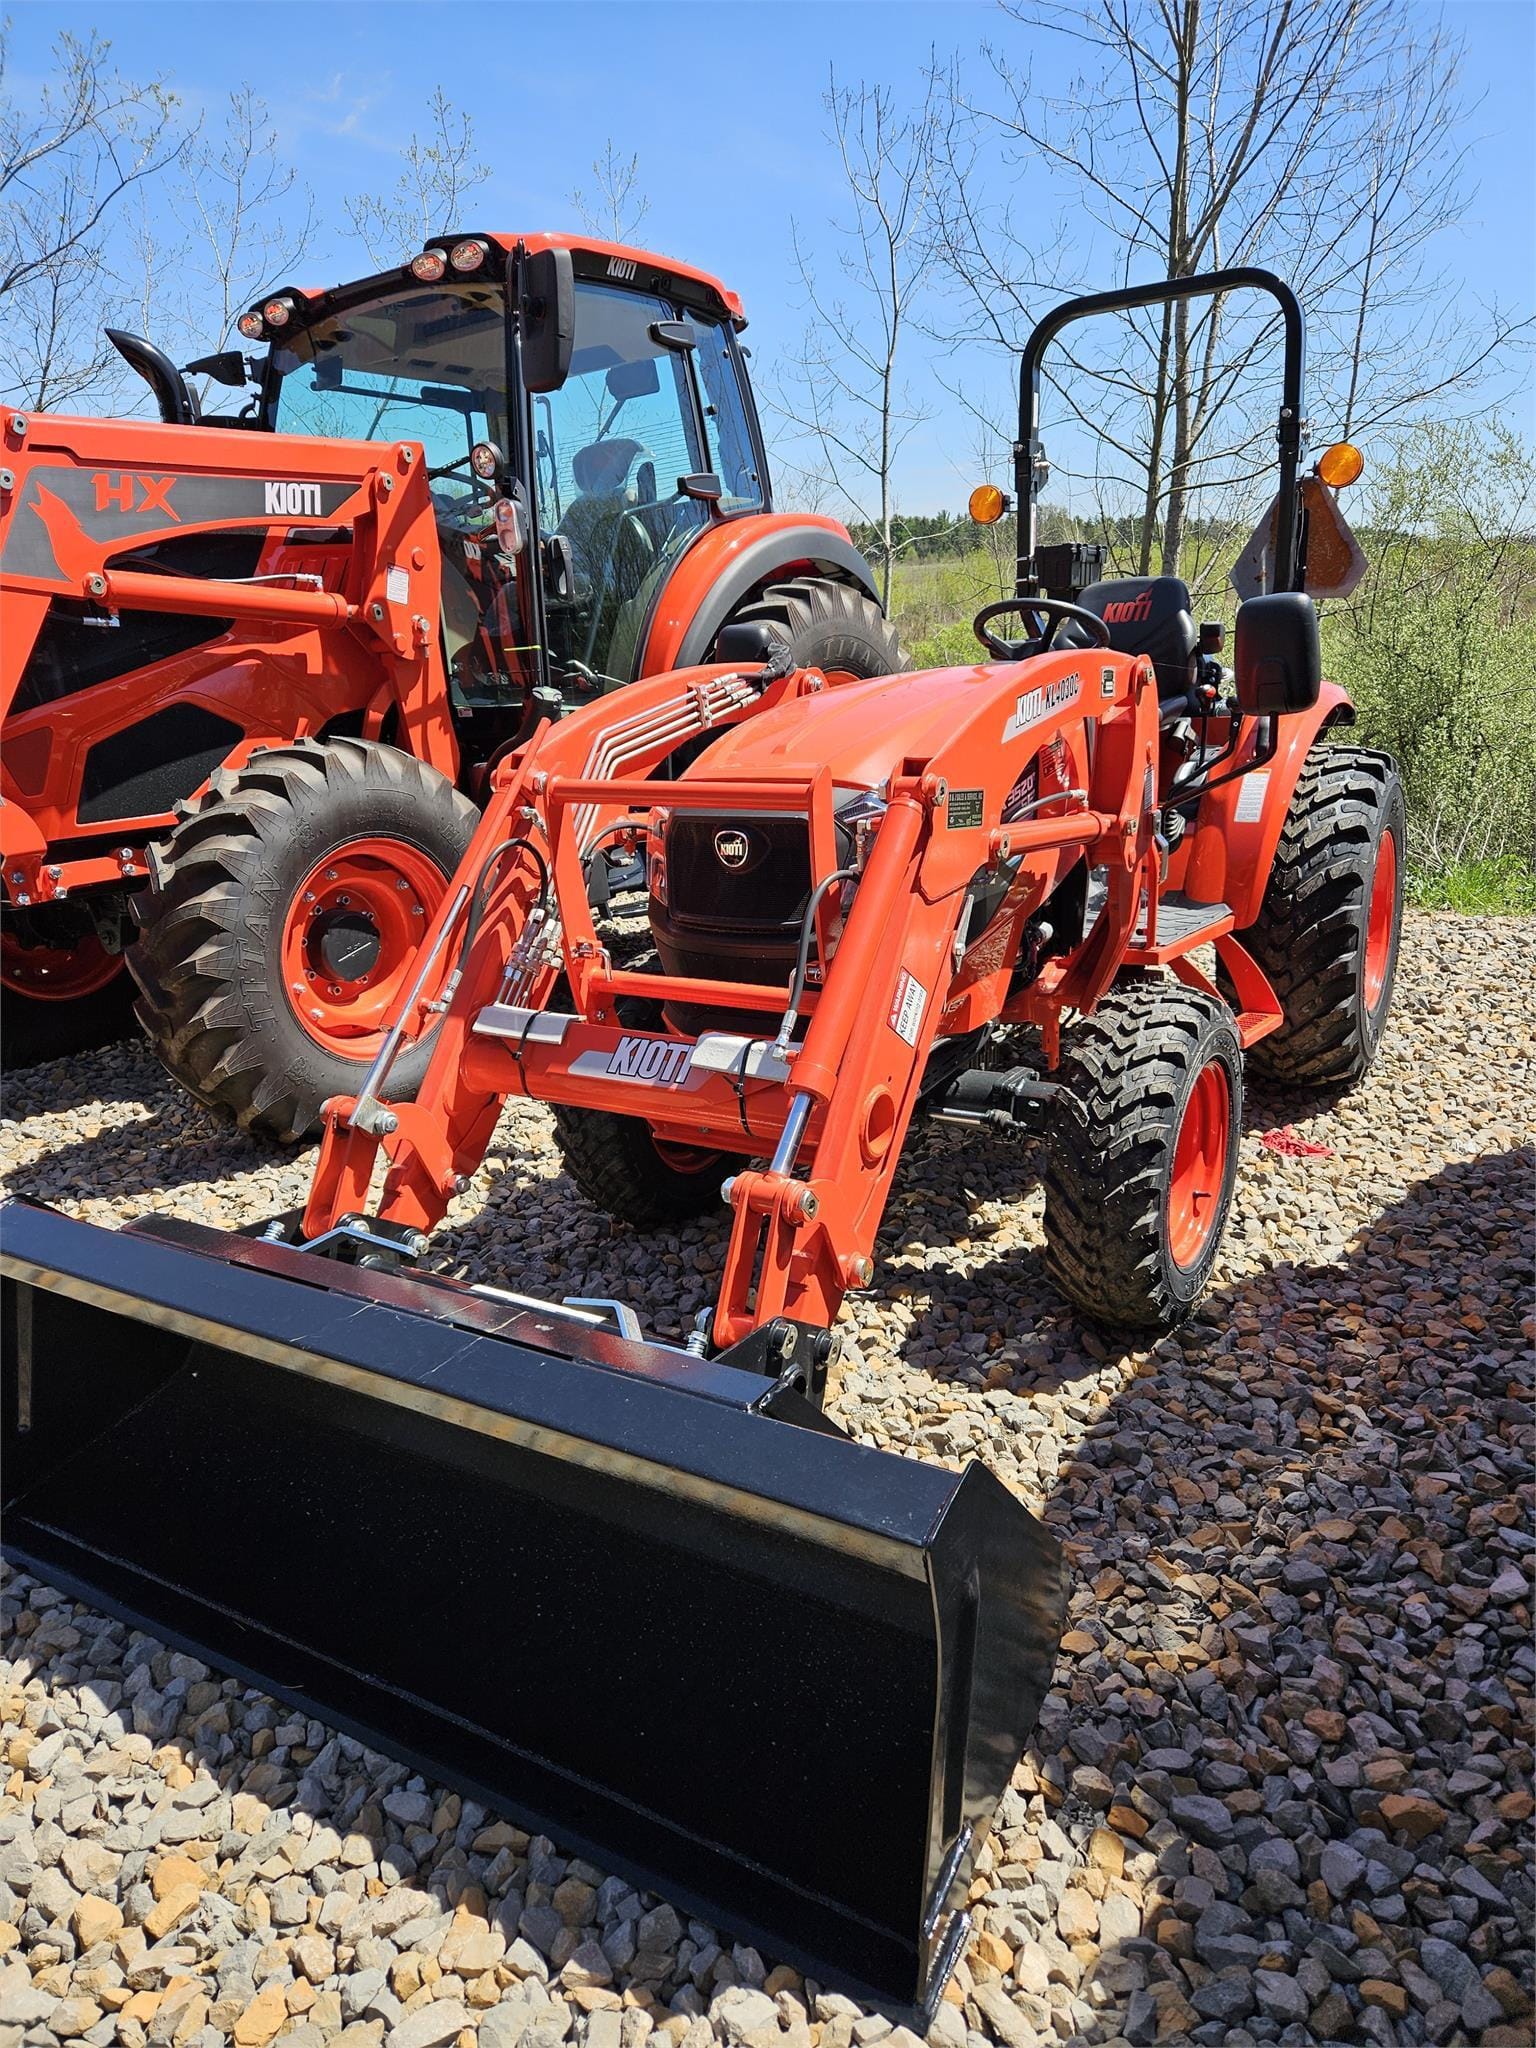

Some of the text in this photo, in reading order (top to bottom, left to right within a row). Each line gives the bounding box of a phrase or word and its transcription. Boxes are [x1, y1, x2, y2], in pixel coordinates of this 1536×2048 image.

[606, 256, 638, 281] KIOTI
[90, 473, 182, 522] HX
[264, 482, 322, 516] KIOTI
[1102, 597, 1153, 624] KIOTI
[1016, 671, 1080, 728] KIOTI KL4030C
[720, 840, 743, 856] KIOTI
[236, 862, 284, 1032] TITAN
[892, 971, 908, 1012] WARNING
[899, 980, 917, 1035] KEEP AWAY
[606, 1035, 696, 1084] KIOTI
